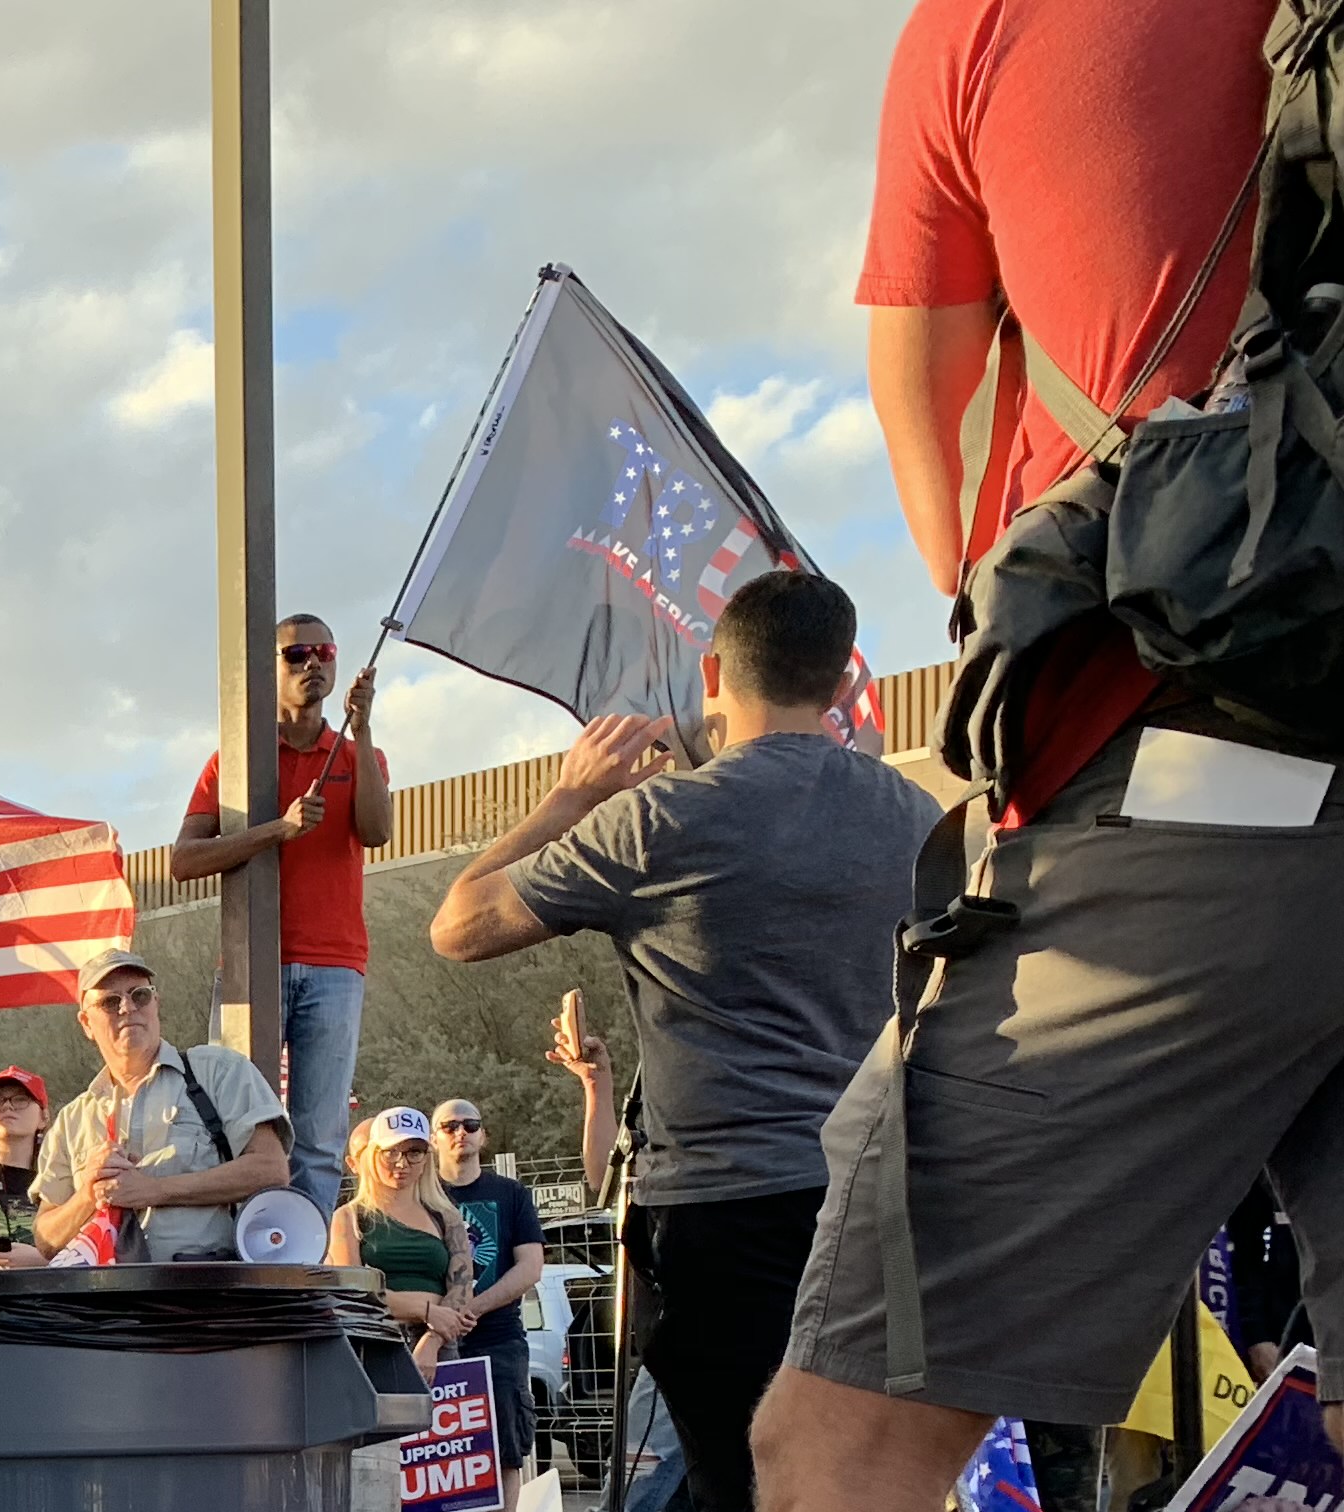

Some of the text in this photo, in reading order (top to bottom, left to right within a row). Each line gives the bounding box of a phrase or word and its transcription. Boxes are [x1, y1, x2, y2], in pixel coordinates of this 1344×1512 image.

[386, 1113, 425, 1133] USA
[536, 1187, 556, 1208] ALL
[557, 1186, 581, 1204] PRO
[431, 1381, 468, 1402] ORT
[1213, 1373, 1259, 1409] DO
[400, 1436, 475, 1465] UPPORT
[400, 1453, 492, 1501] UMP
